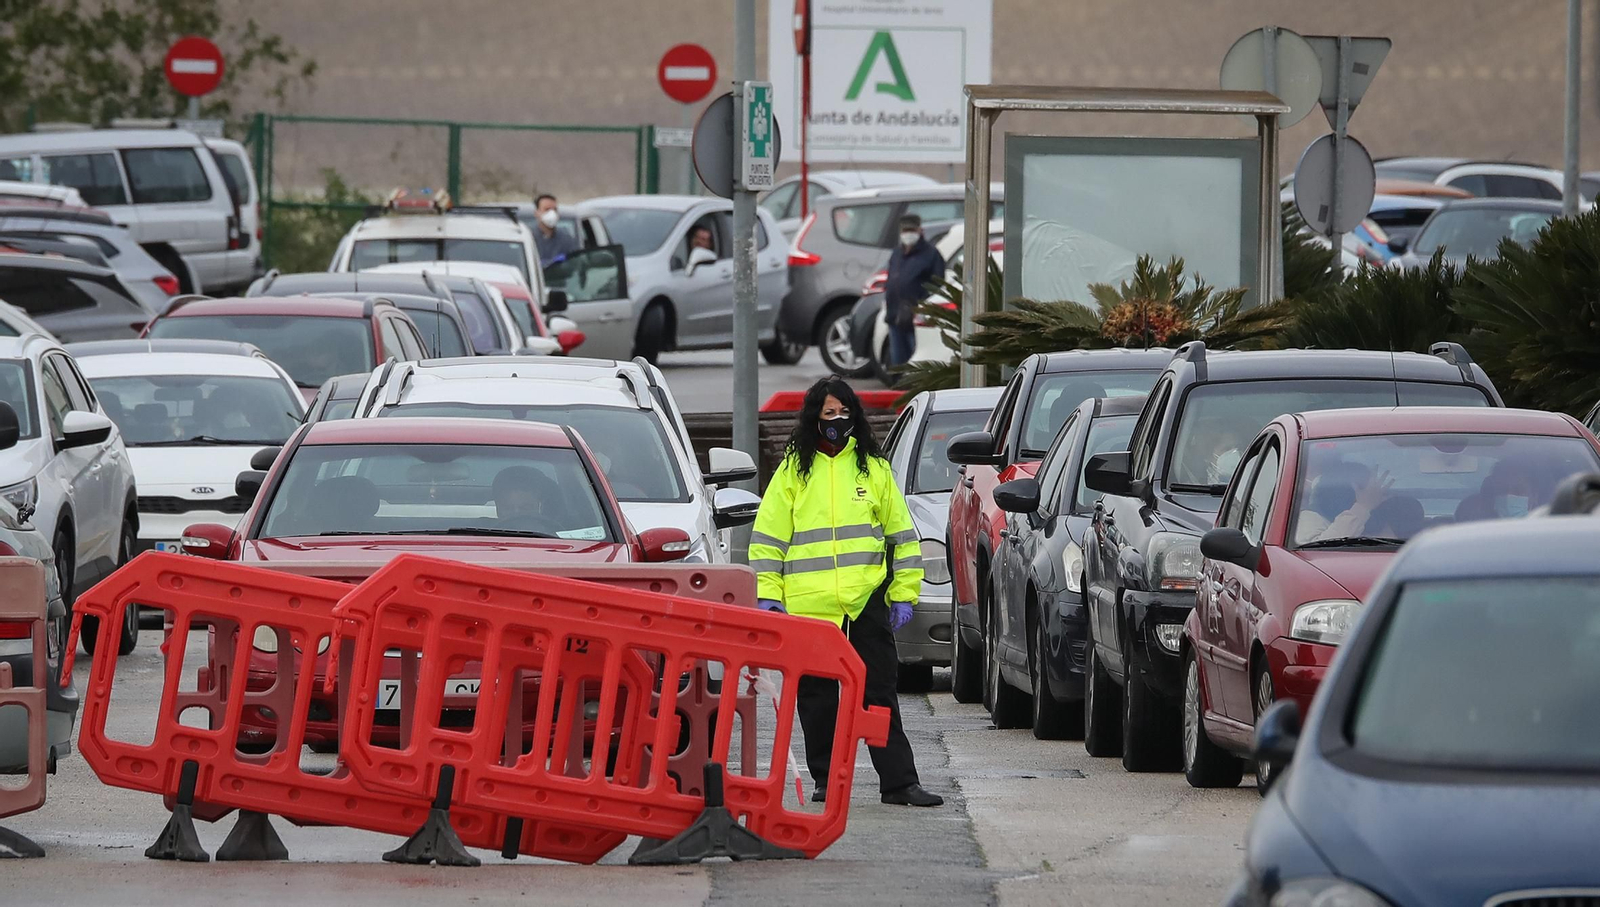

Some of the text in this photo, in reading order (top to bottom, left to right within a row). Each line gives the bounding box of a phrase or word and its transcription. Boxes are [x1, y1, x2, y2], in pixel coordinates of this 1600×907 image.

[851, 109, 873, 126] de
[876, 108, 959, 127] Andalucía
[749, 175, 772, 187] ENCUENTRO
[565, 636, 589, 654] 12
